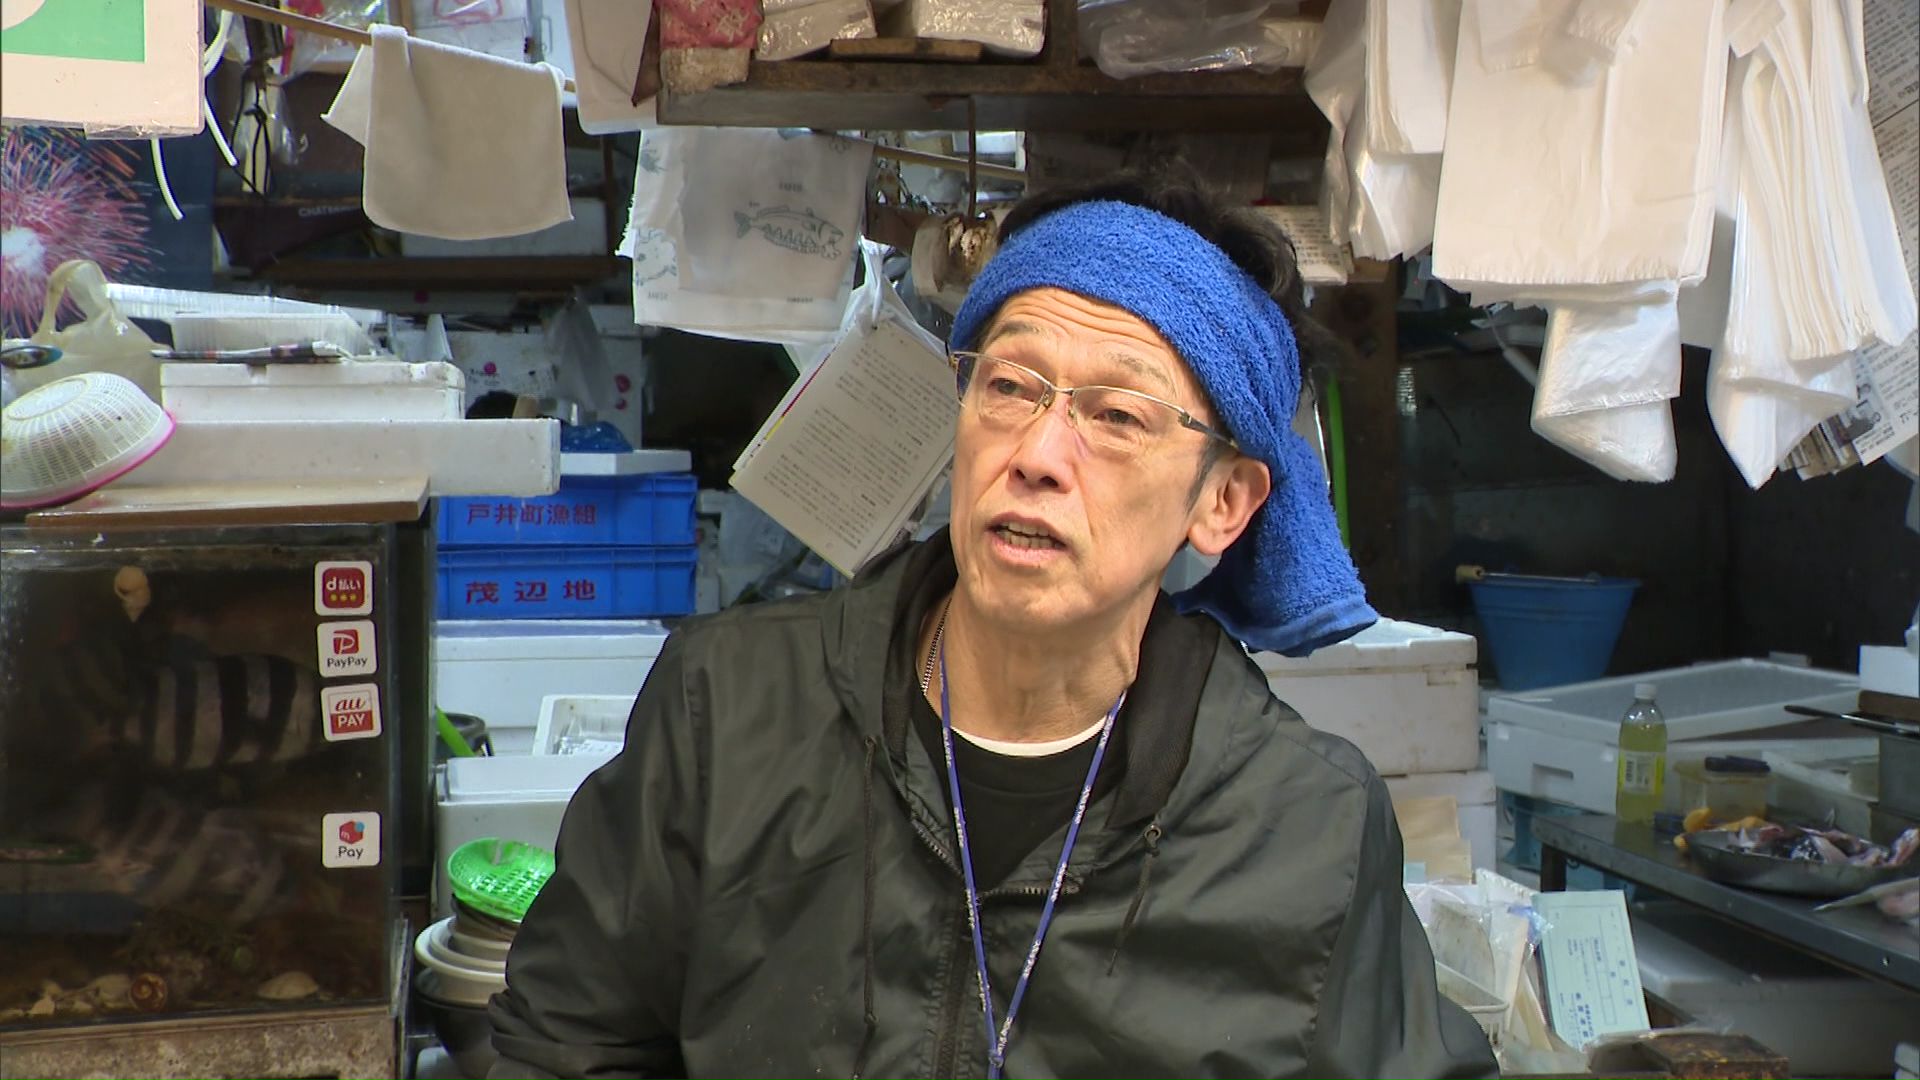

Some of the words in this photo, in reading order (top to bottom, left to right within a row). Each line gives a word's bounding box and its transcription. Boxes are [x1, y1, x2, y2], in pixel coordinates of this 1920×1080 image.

[466, 503, 597, 526] 戸井町漁組
[465, 579, 597, 604] 茂辺地
[327, 655, 368, 669] PayPay
[335, 697, 366, 711] au
[338, 713, 365, 728] PAY
[338, 846, 363, 859] Pay
